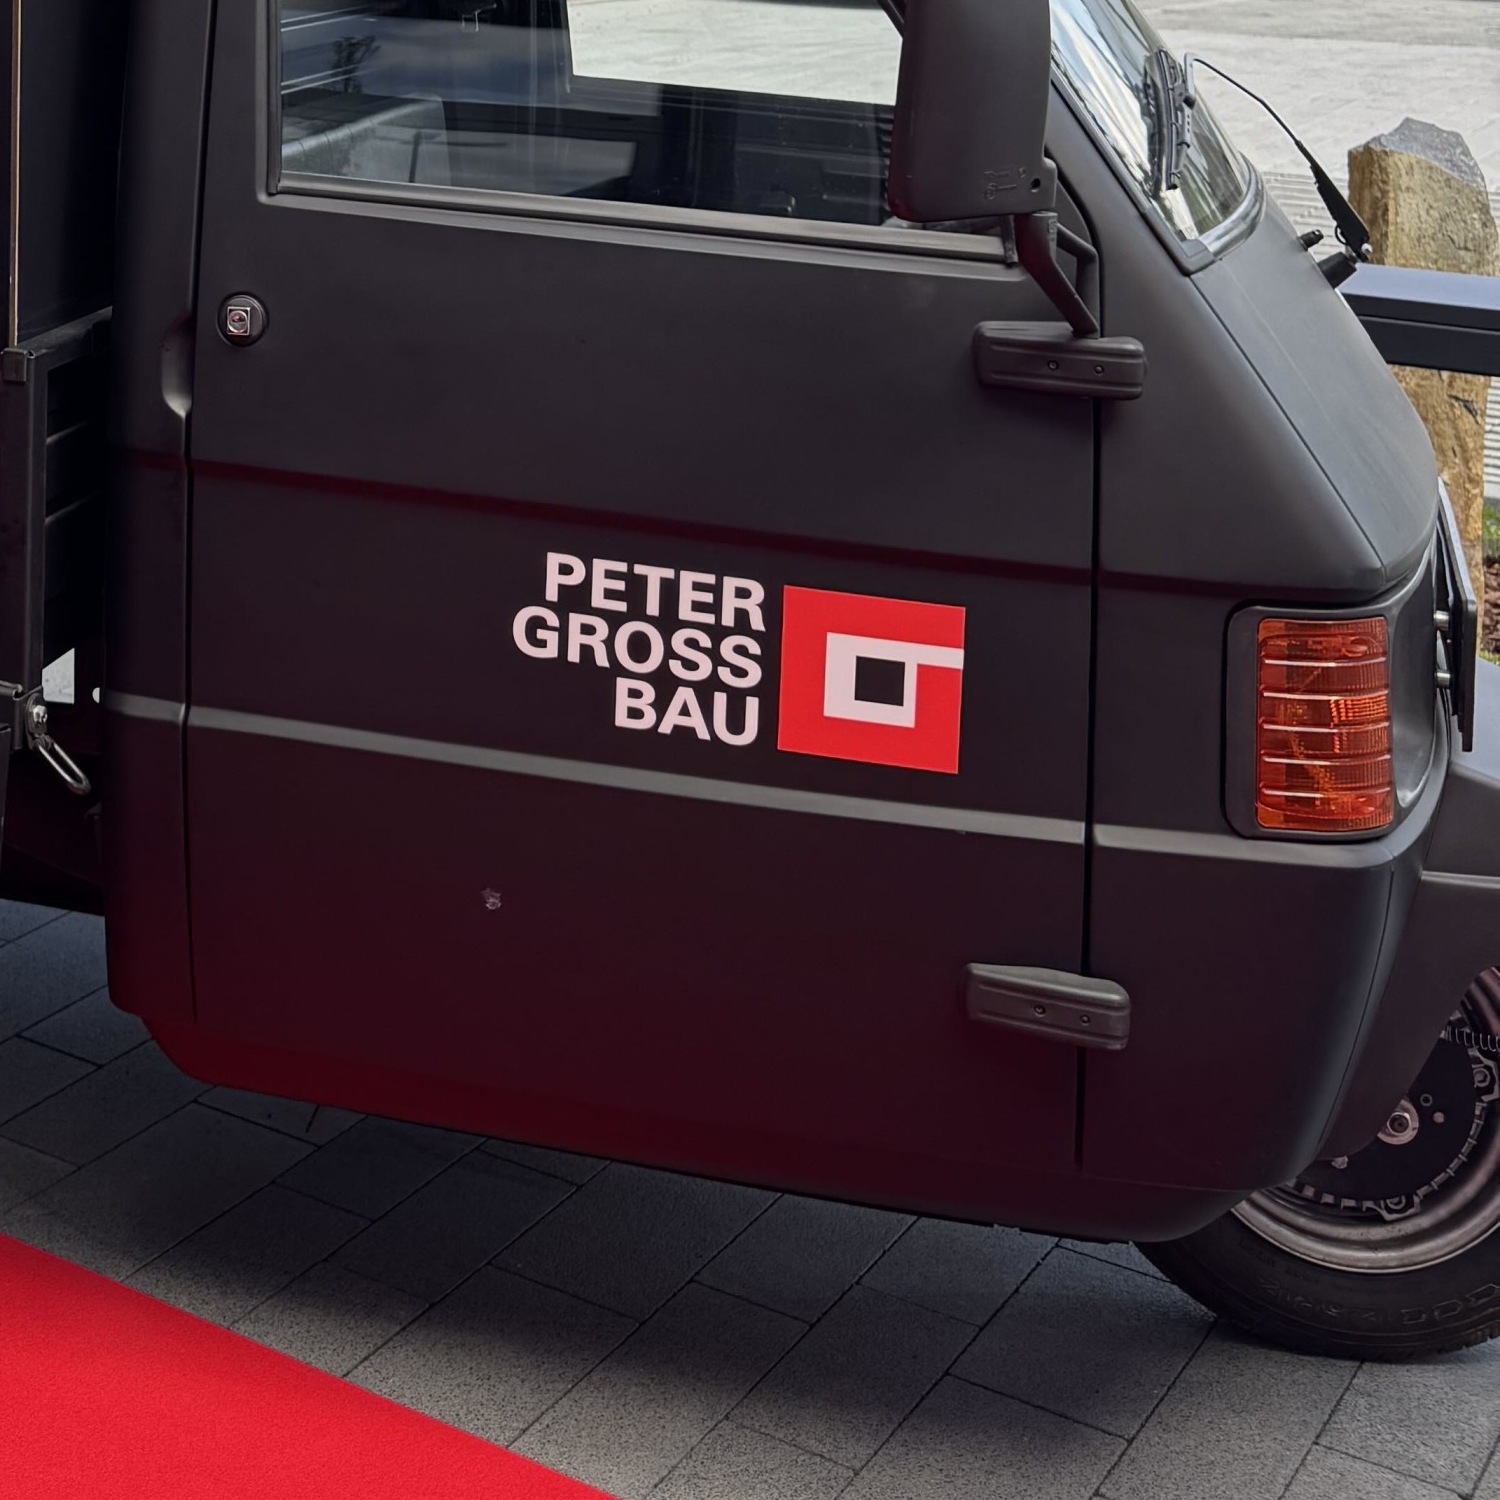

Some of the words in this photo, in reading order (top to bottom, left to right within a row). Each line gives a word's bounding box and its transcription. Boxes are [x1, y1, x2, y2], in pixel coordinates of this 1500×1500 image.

[544, 551, 766, 632] PETER
[512, 605, 763, 689] GROSS
[614, 677, 760, 746] BAU
